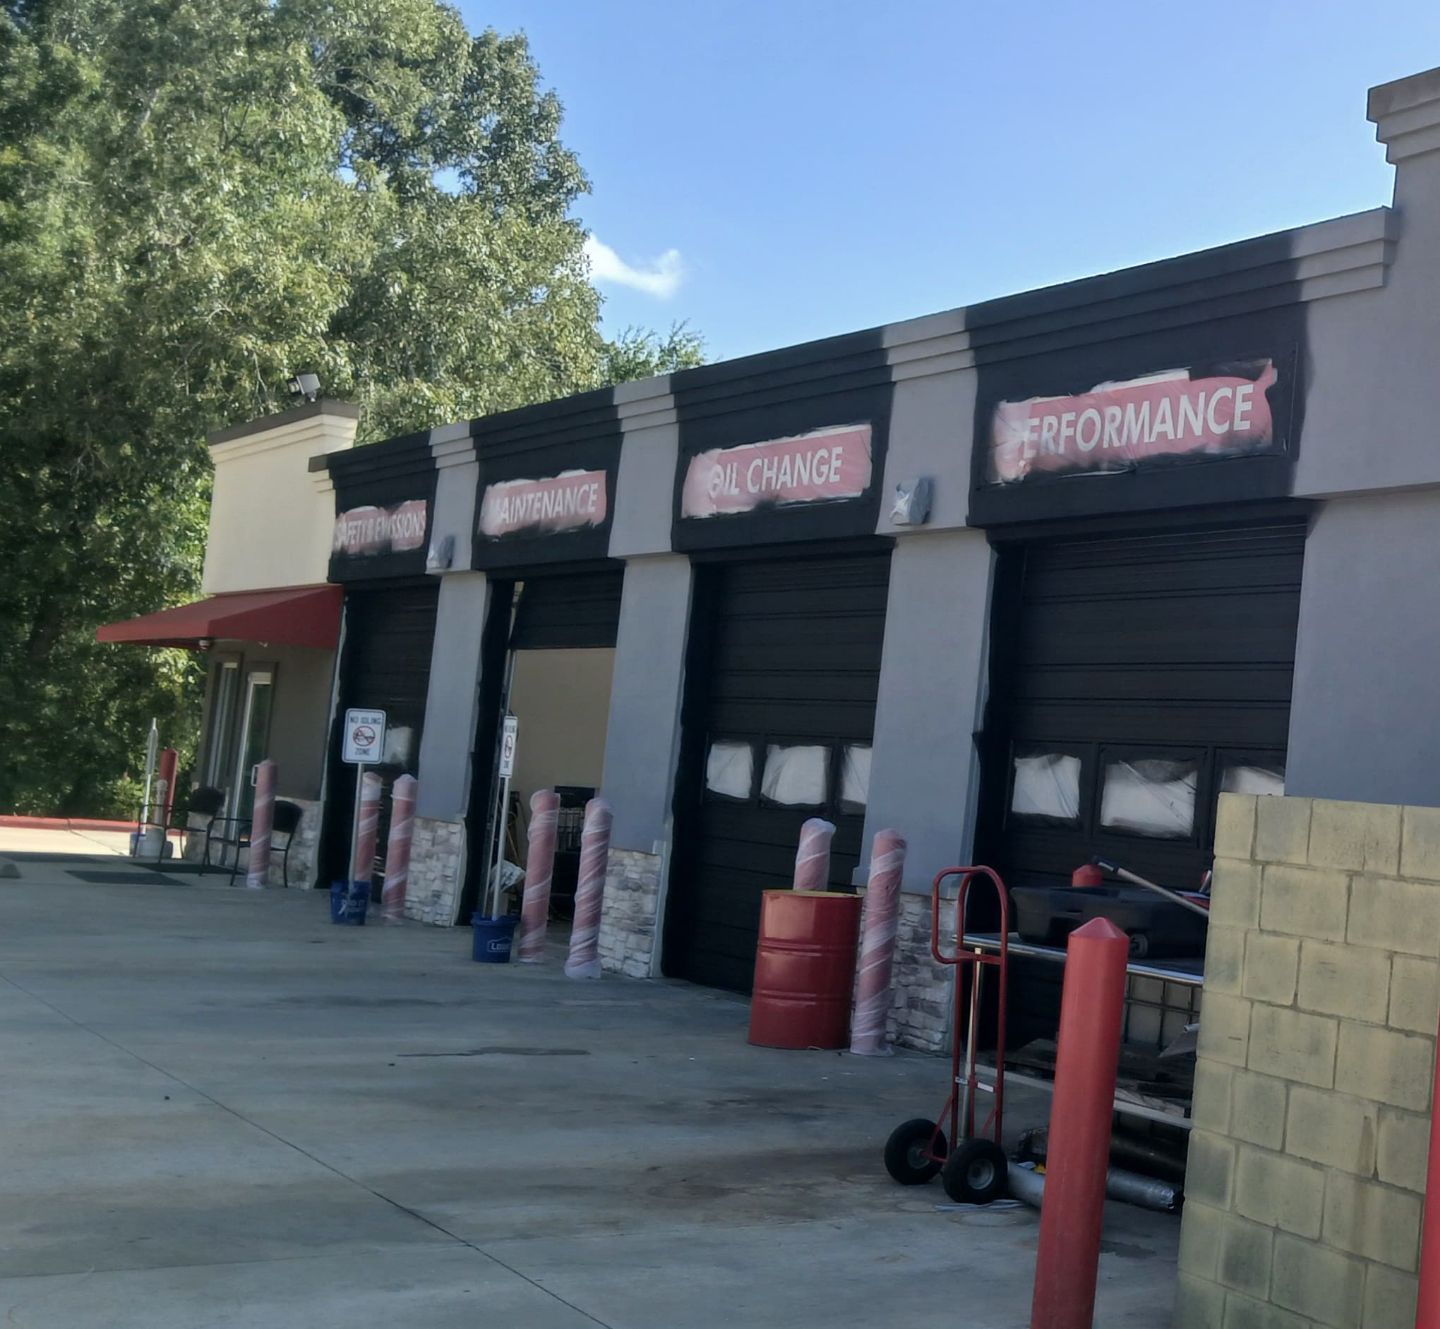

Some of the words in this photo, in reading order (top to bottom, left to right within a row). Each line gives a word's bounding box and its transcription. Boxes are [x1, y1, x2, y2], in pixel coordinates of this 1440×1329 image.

[1021, 384, 1255, 459] ERFORMANCE
[709, 463, 740, 498] OIL
[747, 447, 843, 493] CHANGE
